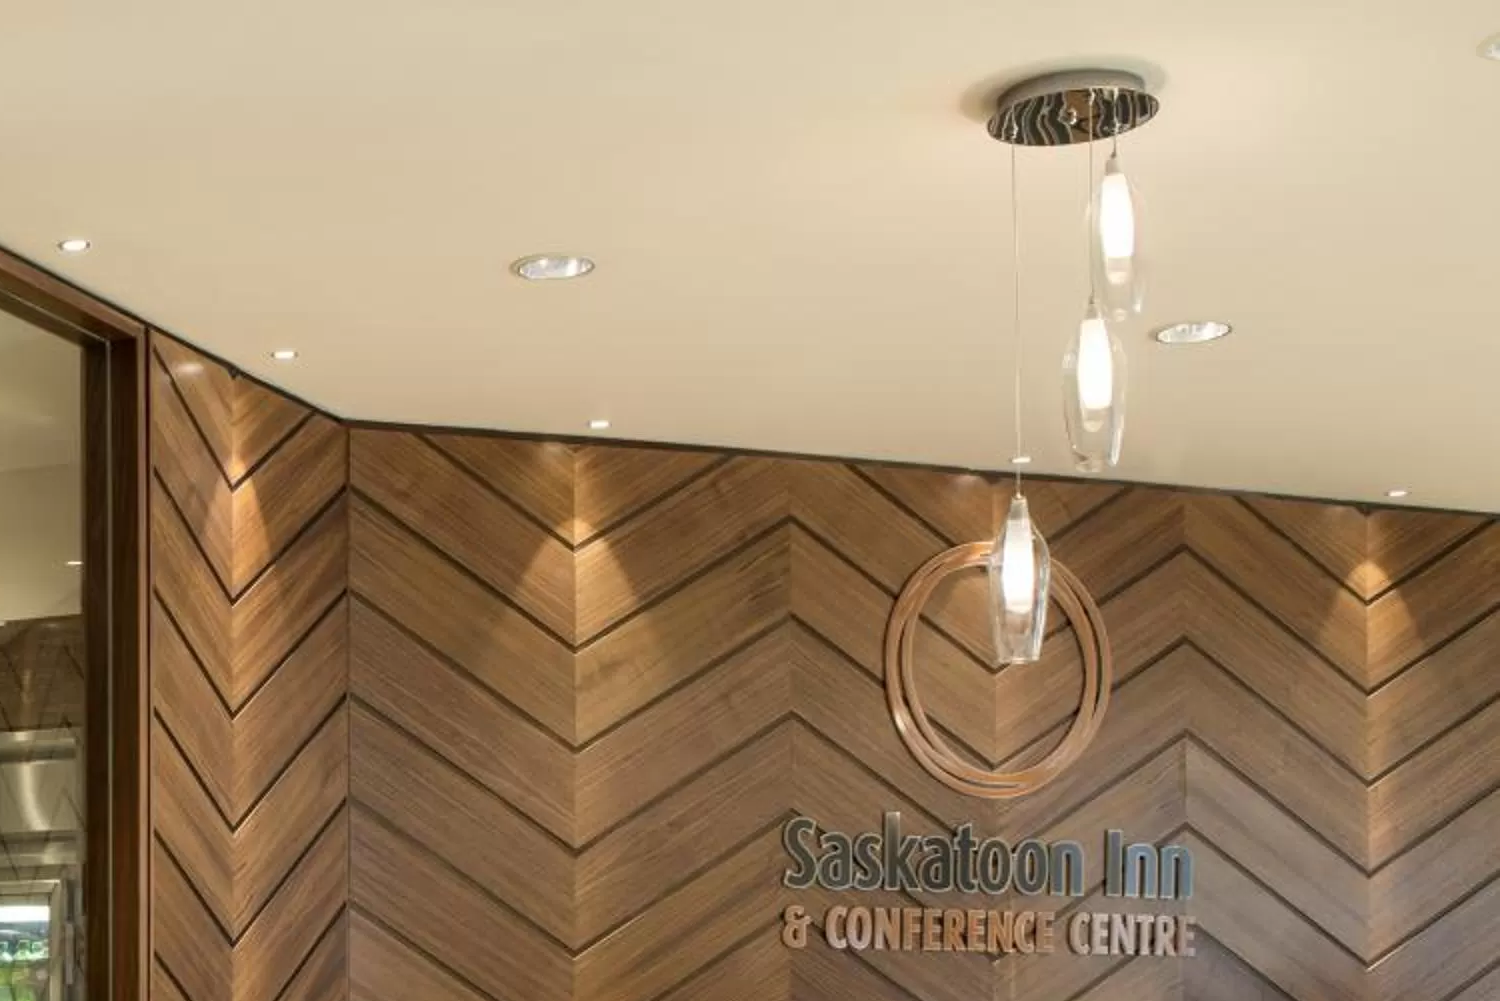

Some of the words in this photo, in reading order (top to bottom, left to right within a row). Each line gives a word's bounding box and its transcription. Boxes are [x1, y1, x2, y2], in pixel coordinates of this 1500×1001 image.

[784, 811, 1085, 895] Saskatoon
[1103, 829, 1194, 899] Inn
[782, 904, 812, 949] &
[825, 906, 1055, 953] CONFERENCE
[1069, 912, 1197, 957] CENTRE
